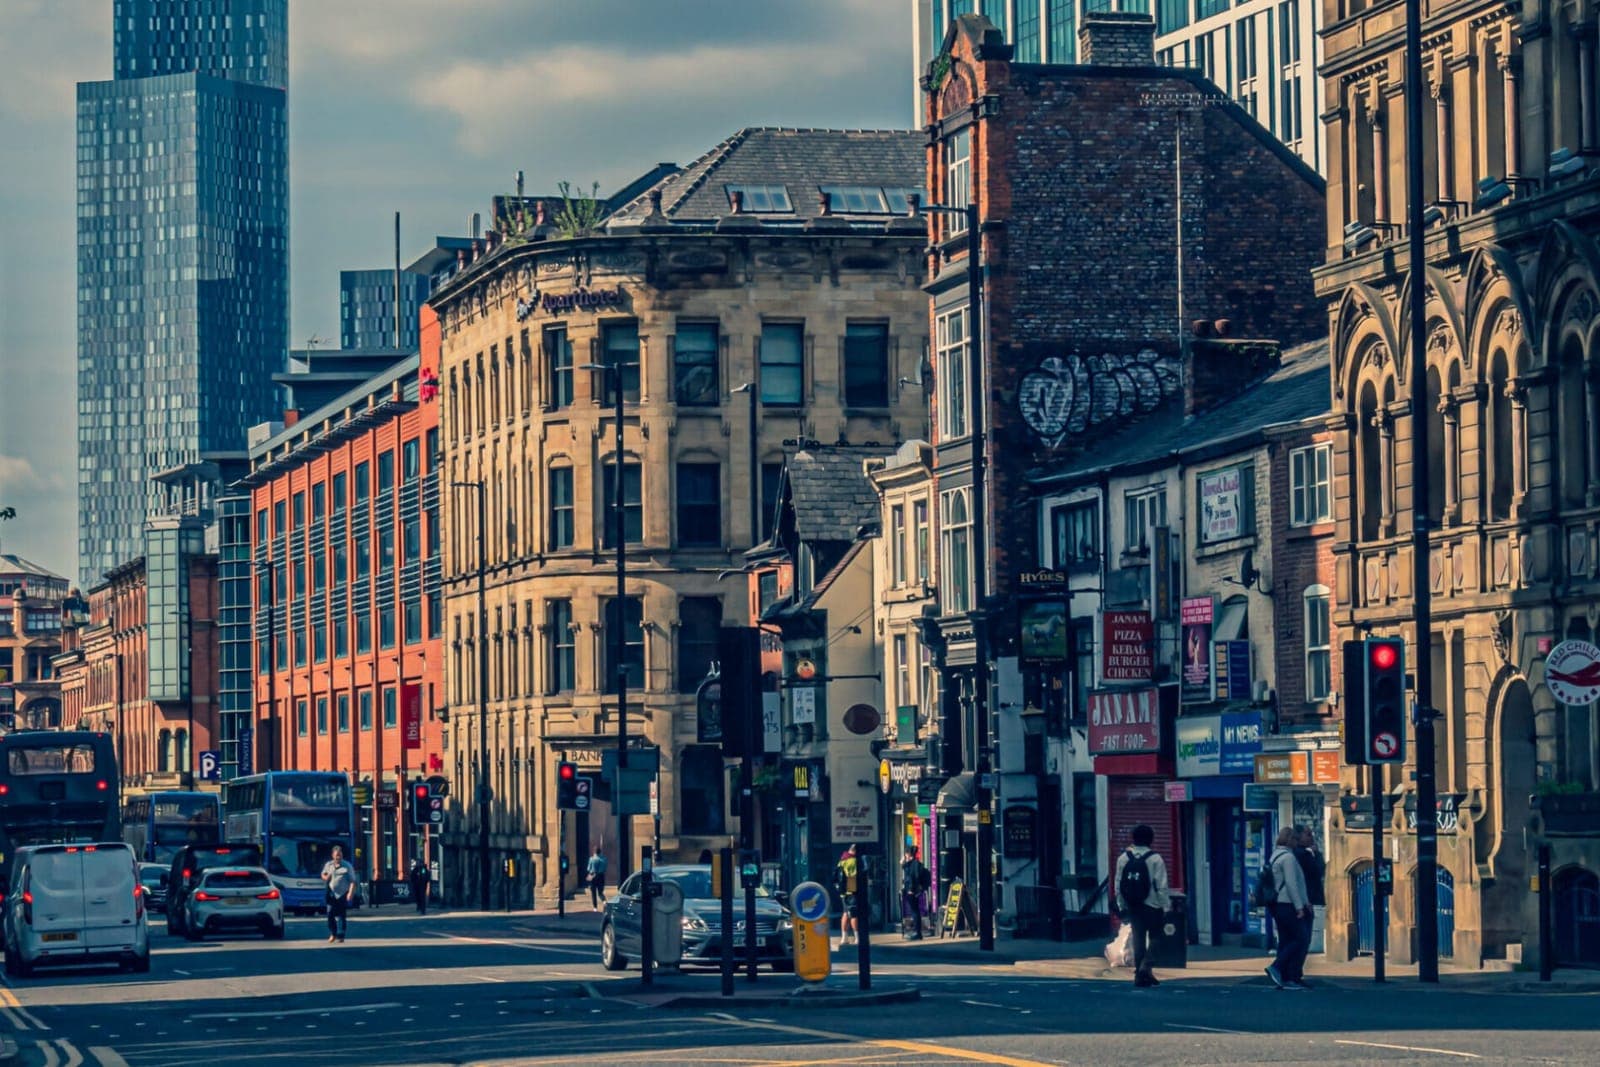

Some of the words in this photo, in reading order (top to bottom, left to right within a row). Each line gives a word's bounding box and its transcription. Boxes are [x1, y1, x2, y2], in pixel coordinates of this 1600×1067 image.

[542, 283, 623, 312] Aparthotel
[1020, 569, 1065, 583] HYDES
[1112, 615, 1146, 624] JANAM
[1114, 630, 1142, 640] PIZZA
[1112, 644, 1146, 655] KEBAB
[1108, 656, 1150, 667] BURGER
[1551, 648, 1565, 666] RED
[1107, 667, 1152, 678] CHICKEN
[1093, 691, 1150, 726] JANAM
[1236, 724, 1259, 744] NEWS
[1124, 734, 1143, 749] FOOD
[203, 758, 215, 778] P
